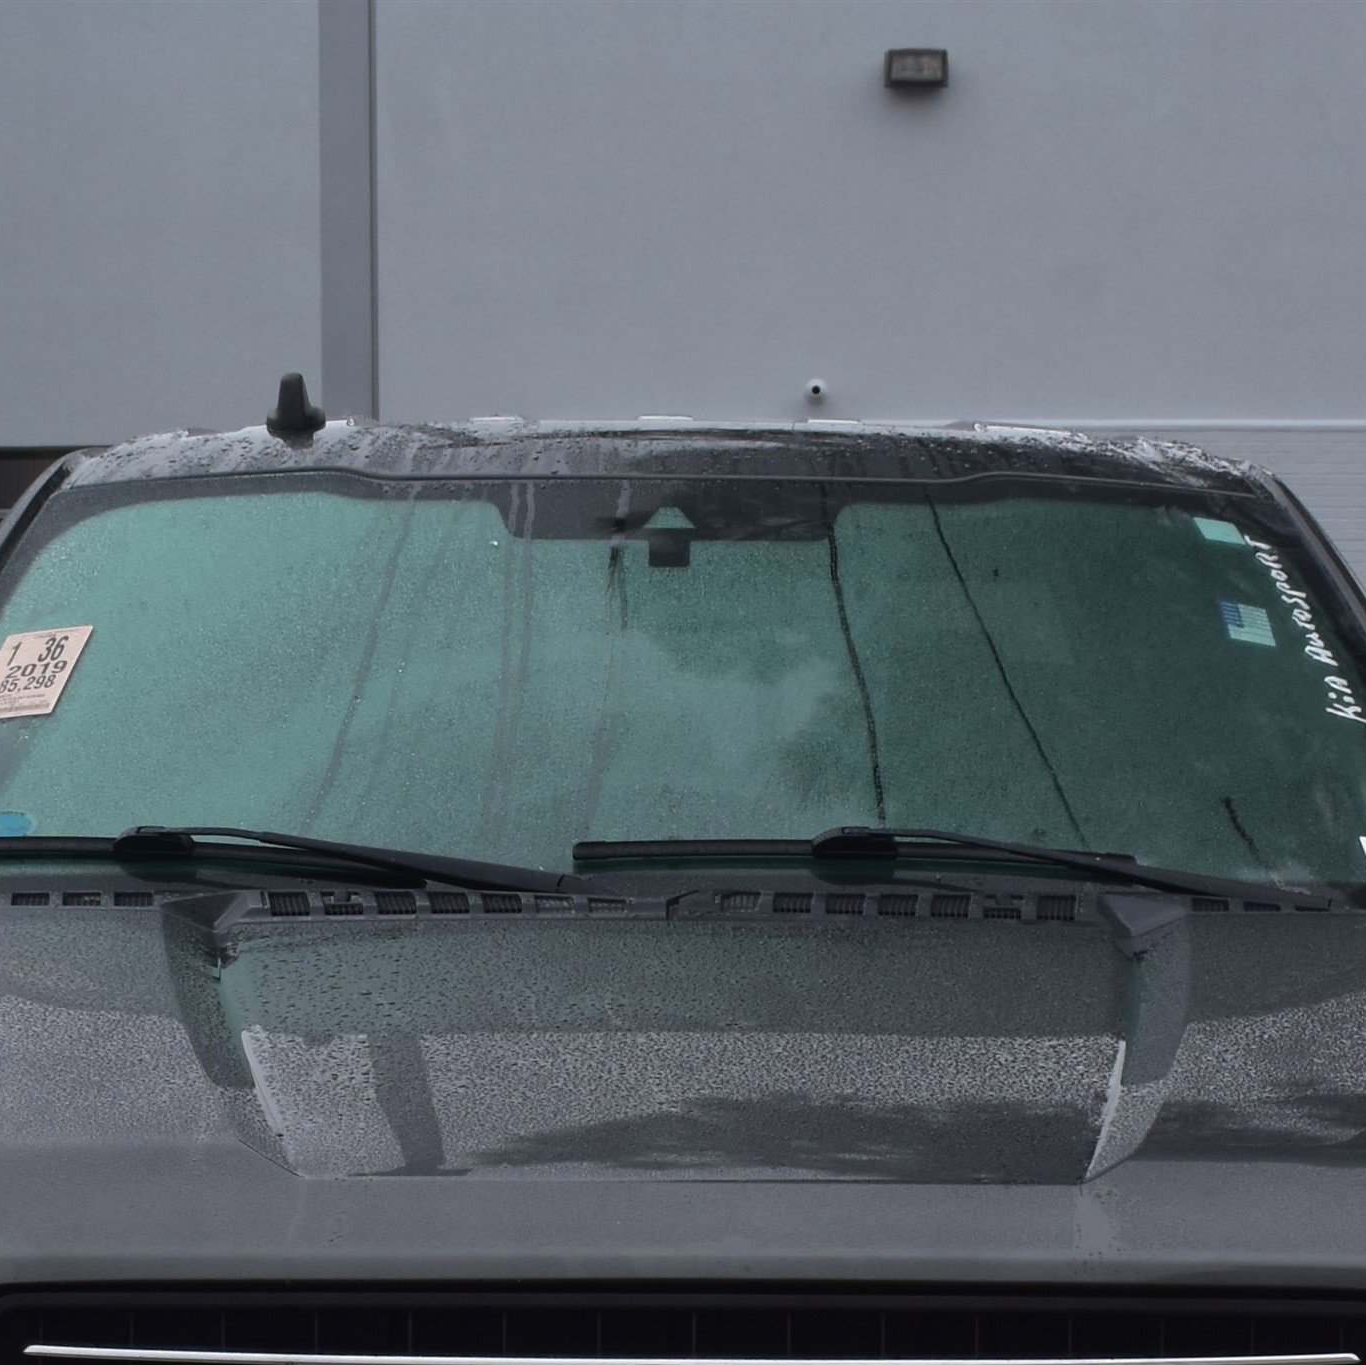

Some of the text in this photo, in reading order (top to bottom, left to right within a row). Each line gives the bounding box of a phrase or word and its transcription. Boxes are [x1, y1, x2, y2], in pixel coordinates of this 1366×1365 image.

[6, 635, 70, 666] 1 36
[4, 659, 68, 679] 2019
